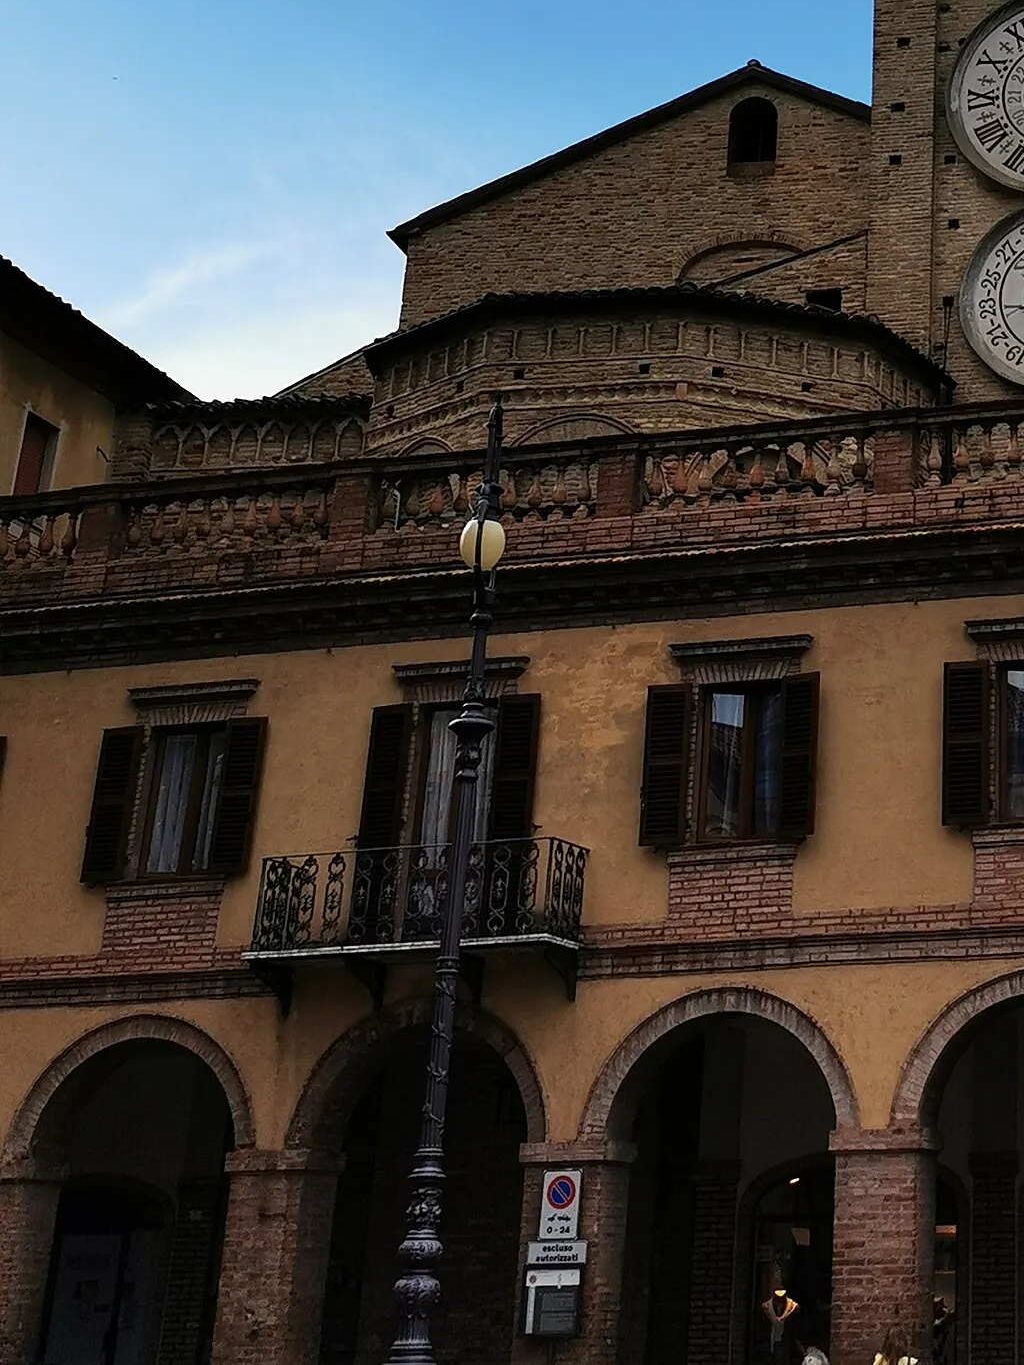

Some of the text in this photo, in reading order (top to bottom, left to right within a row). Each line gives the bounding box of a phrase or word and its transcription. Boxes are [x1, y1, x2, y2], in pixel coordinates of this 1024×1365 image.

[975, 49, 1008, 75] X
[967, 89, 996, 112] IX
[1007, 90, 1022, 104] 21
[973, 118, 1009, 154] VIII
[995, 239, 1018, 264] 27
[980, 268, 1001, 290] 25
[978, 297, 996, 319] 23
[986, 323, 1009, 346] 21
[559, 1226, 571, 1234] 24
[535, 1253, 579, 1262] autorizzati
[542, 1244, 574, 1253] escluso
